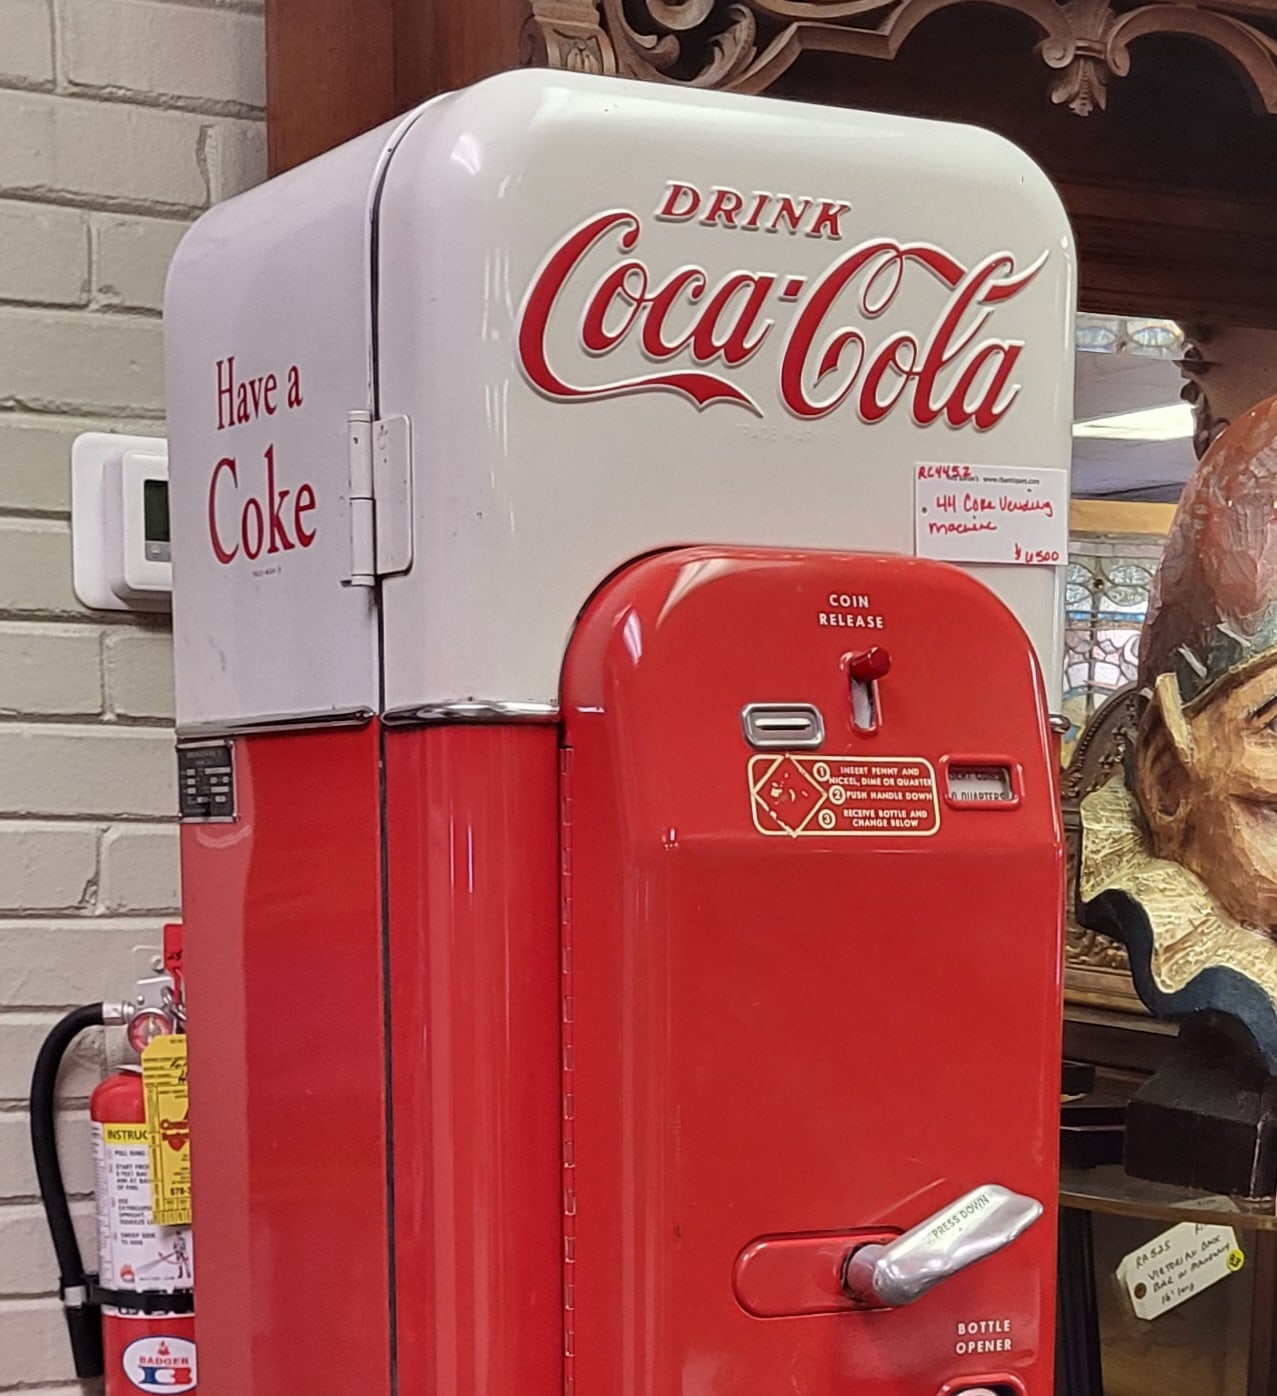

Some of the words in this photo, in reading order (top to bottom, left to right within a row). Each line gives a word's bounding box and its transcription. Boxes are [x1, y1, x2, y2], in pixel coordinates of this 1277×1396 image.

[655, 180, 851, 240] DRINK
[518, 209, 1050, 431] Coca-Cola
[216, 356, 278, 430] Have
[287, 364, 304, 409] a
[208, 443, 317, 565] Coke
[936, 494, 956, 513] 44
[829, 594, 869, 608] COIN
[819, 613, 884, 629] RELEASE
[840, 766, 868, 775] INSERT
[871, 767, 898, 776] PENNY
[901, 767, 919, 776] AND
[829, 776, 860, 787] NICKEL,
[861, 777, 882, 786] DIME
[883, 778, 895, 787] OR
[897, 778, 932, 787] QUARTER
[846, 791, 867, 800] PUSH
[870, 791, 903, 801] HANDLE
[906, 791, 932, 801] DOWN
[843, 809, 875, 819] RECEIVE
[878, 809, 907, 819] BOTTLE
[910, 810, 928, 819] AND
[852, 818, 888, 828] CHANGE
[890, 818, 919, 828] BELOW
[931, 1214, 961, 1239] PRESS
[960, 1194, 990, 1219] DOWN
[958, 1320, 1011, 1335] BOTTLE
[956, 1338, 1012, 1354] OPENER
[139, 1355, 189, 1365] BADGER
